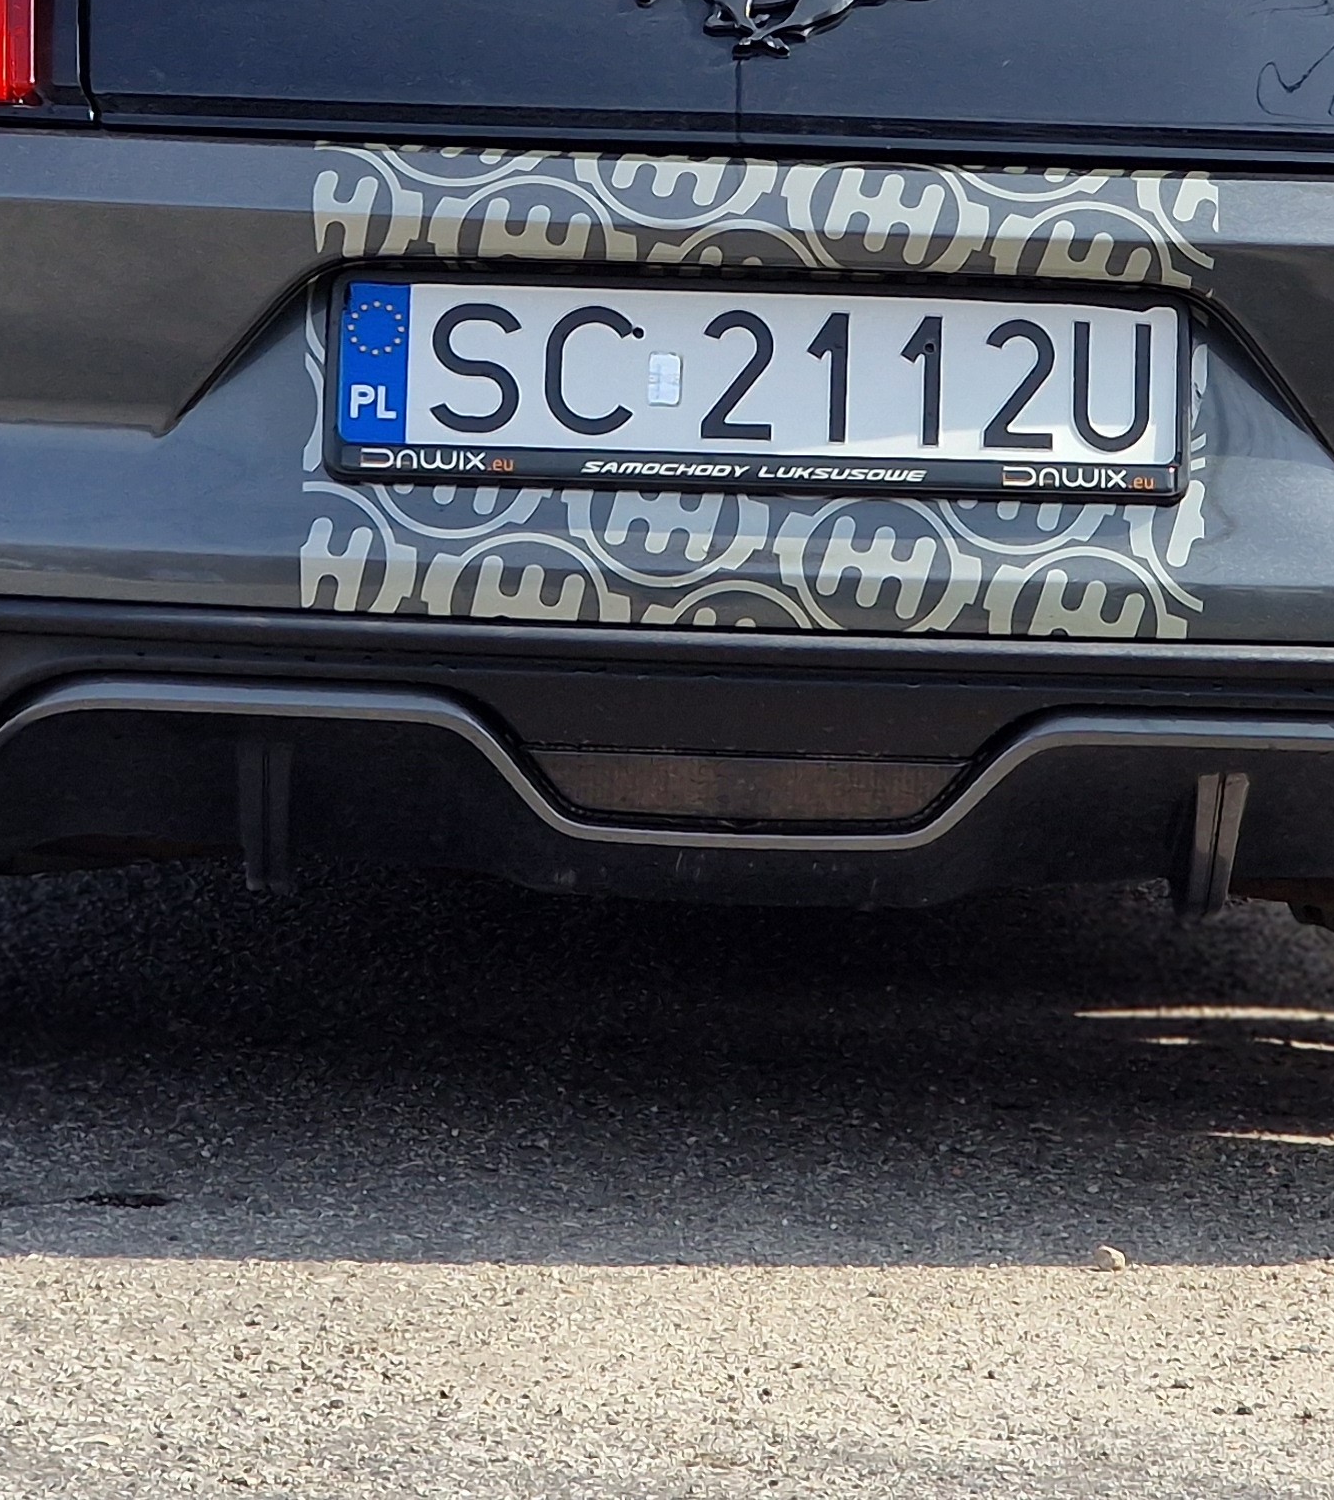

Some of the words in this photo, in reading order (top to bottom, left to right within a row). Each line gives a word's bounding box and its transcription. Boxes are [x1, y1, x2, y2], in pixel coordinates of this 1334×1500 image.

[429, 302, 634, 437] SC
[700, 309, 1153, 453] 2112U
[349, 383, 398, 420] PL
[581, 460, 751, 479] SAMOCHODY
[757, 464, 928, 483] LUKSUSOWE
